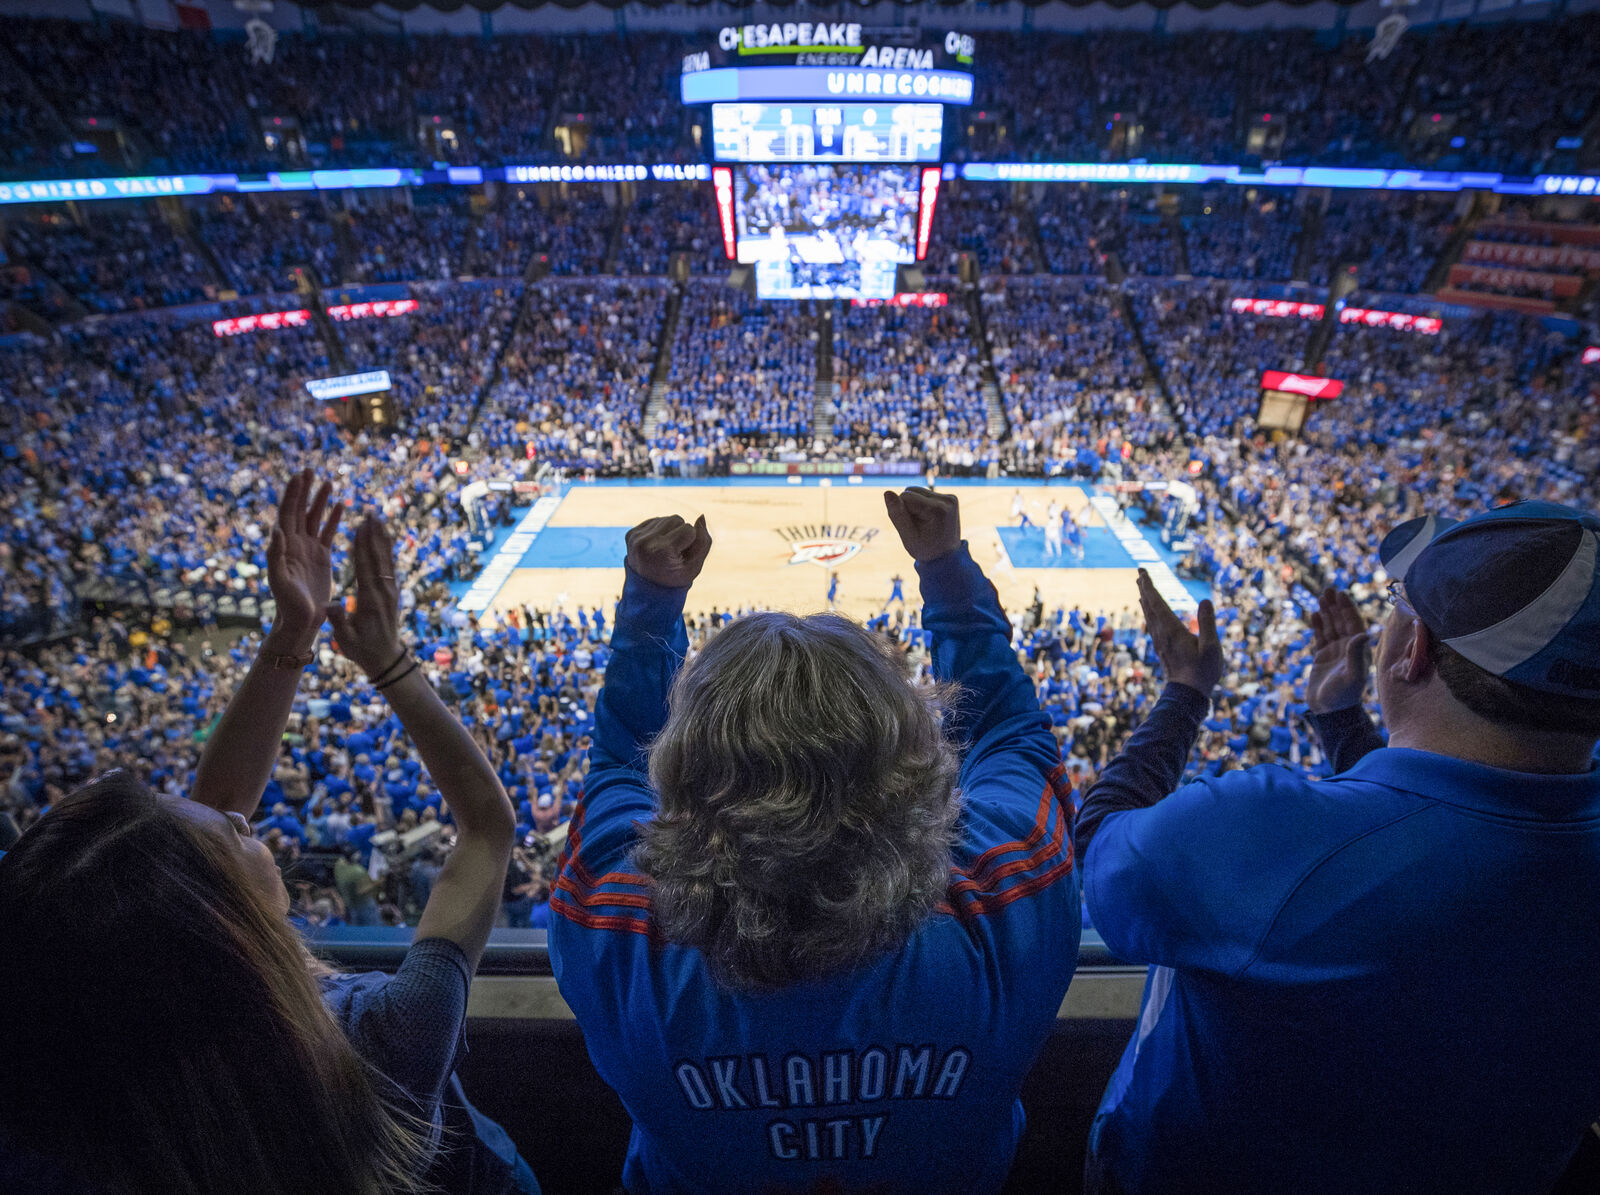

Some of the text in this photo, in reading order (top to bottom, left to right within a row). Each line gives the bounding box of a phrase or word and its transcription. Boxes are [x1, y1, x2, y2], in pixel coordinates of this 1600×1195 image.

[719, 22, 863, 51] CHESAPEAKE
[859, 45, 934, 69] ARENA
[652, 163, 709, 180] VALUE
[114, 177, 186, 194] VALUE
[772, 524, 880, 543] THUNDER
[675, 1047, 971, 1109] OKLAHOMA
[768, 1115, 885, 1160] CITY
